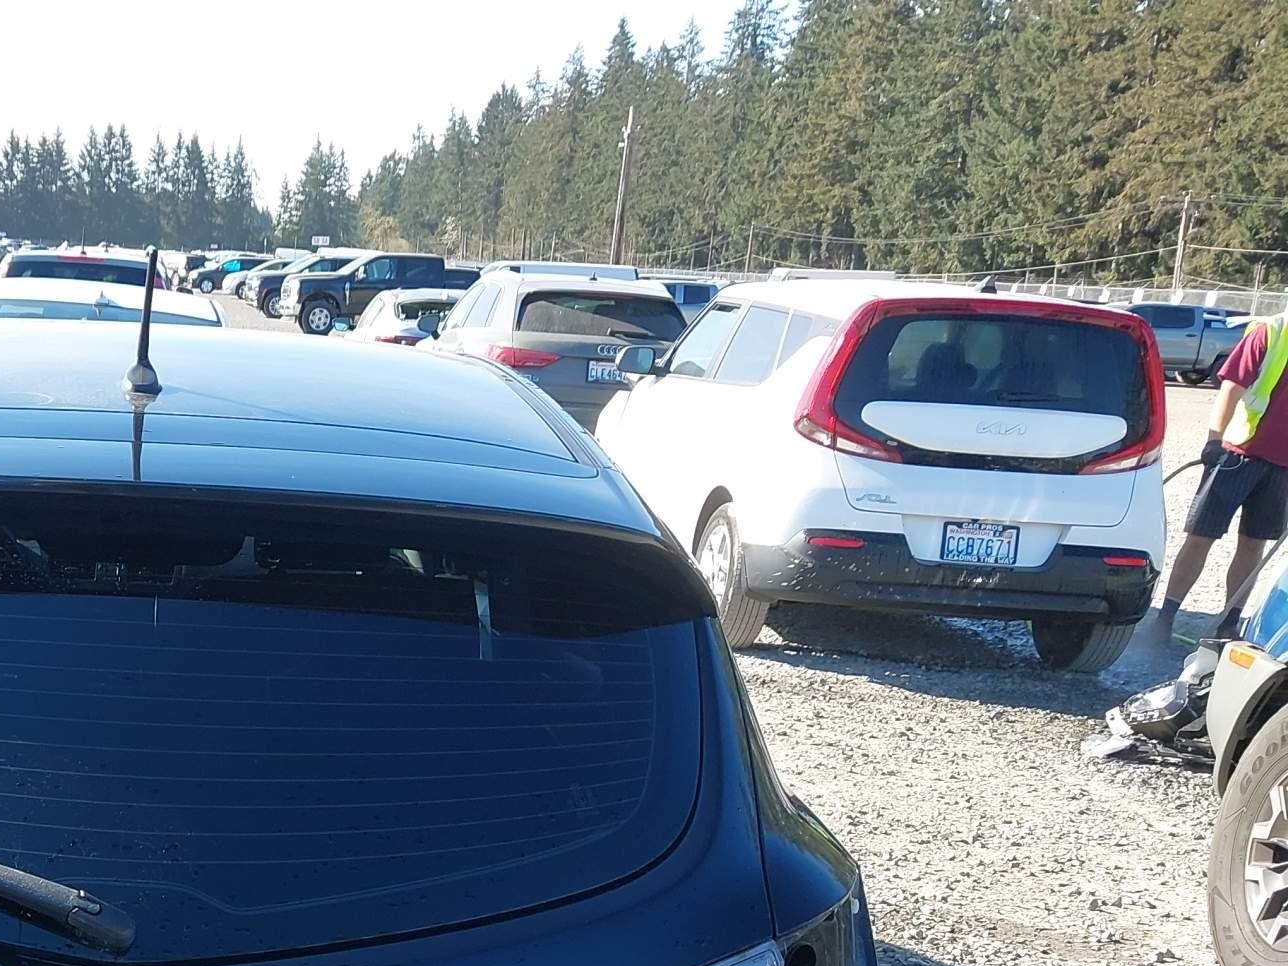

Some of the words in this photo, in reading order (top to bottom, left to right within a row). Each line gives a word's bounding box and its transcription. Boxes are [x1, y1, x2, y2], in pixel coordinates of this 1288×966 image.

[947, 536, 1012, 559] CCB7671
[980, 556, 995, 564] THE
[997, 557, 1014, 565] WAY
